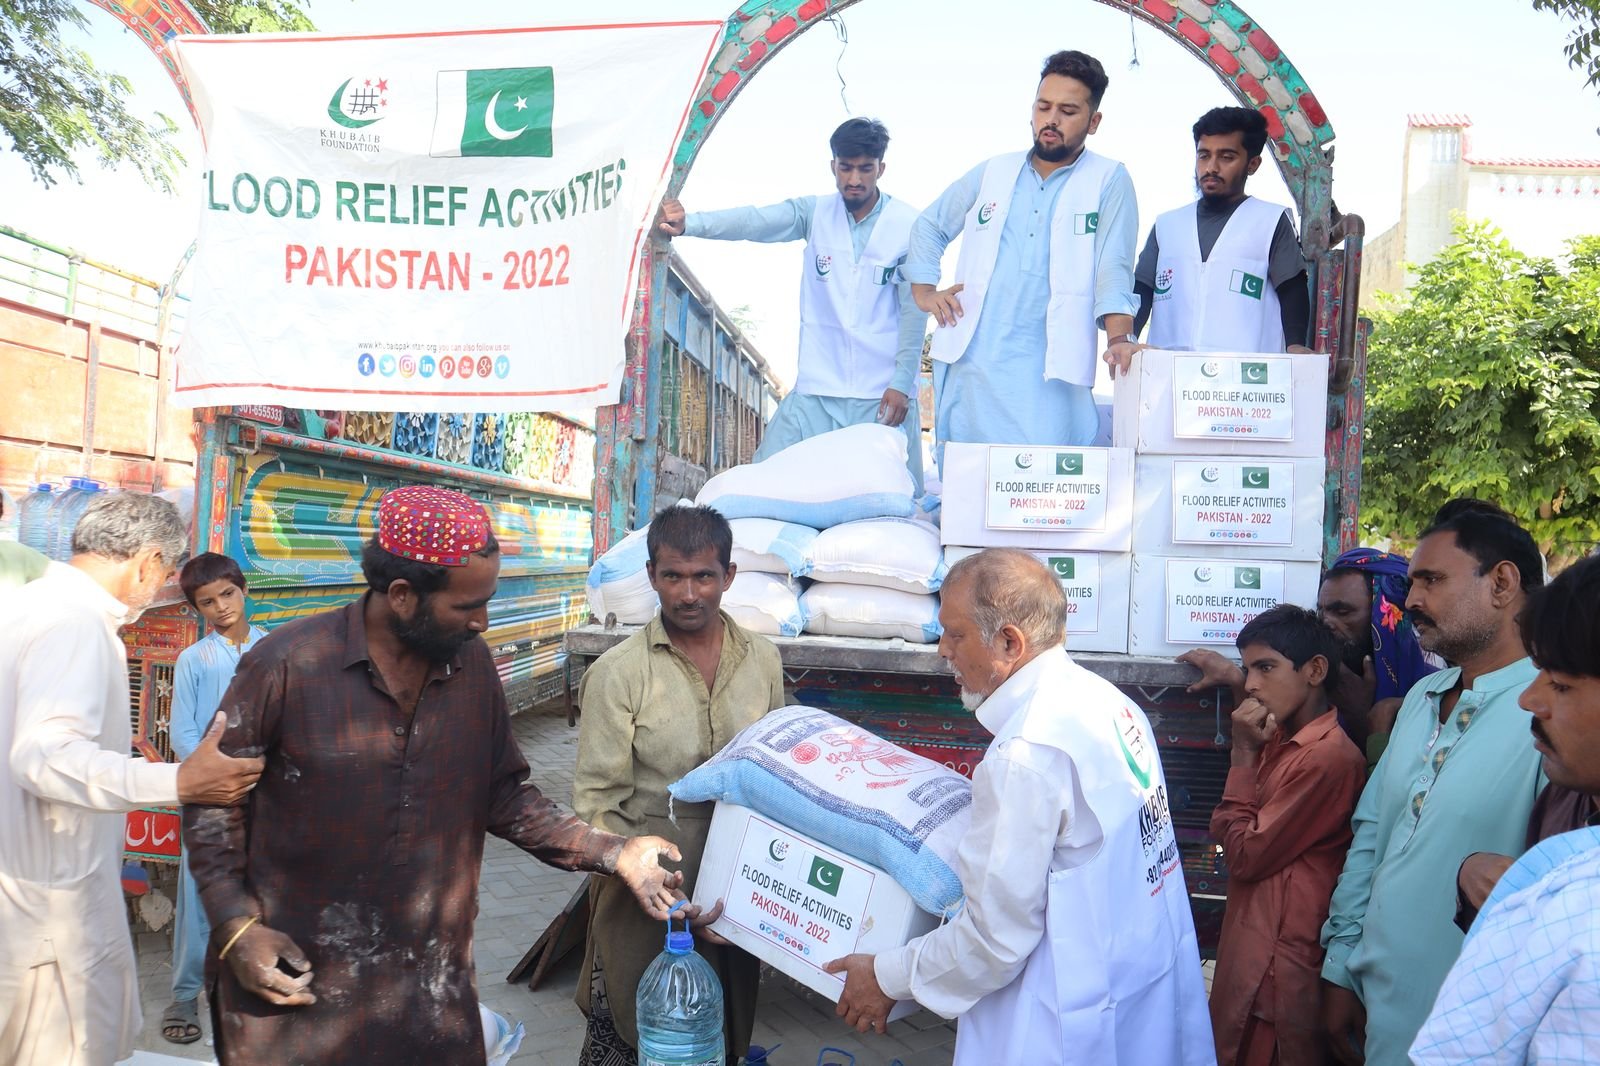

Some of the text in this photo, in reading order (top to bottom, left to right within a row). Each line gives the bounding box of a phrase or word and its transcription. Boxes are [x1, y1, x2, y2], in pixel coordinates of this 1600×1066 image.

[320, 129, 380, 143] KHUBAIB
[321, 138, 380, 153] FOUNDATION
[203, 170, 320, 219] LOOD
[336, 181, 468, 226] RELIEF
[285, 244, 470, 291] PAKISTAN
[503, 244, 570, 291] 2022
[1182, 390, 1285, 403] FLOOD RELIEF ACTIVITIES
[1198, 406, 1243, 418] PAKISTAN
[1251, 408, 1271, 419] 2022
[996, 482, 1100, 495] FLOOD RELIEF ACTIVITIES
[1010, 498, 1056, 509] PAKISTAN
[1065, 499, 1085, 510] 2022
[1182, 495, 1286, 508] FLOOD RELIEF ACTIVITIES
[1197, 511, 1242, 523] PAKISTAN
[1251, 513, 1271, 524] 2022
[1176, 594, 1277, 609] FLOOD RELIEF ACTIVITIES
[1067, 603, 1078, 614] 22
[1191, 611, 1235, 624] PAKISTAN
[741, 864, 853, 930] FLOOD RELIEF ACTIVITIES
[750, 891, 799, 928] PAKISTAN
[805, 921, 831, 944] 2022
